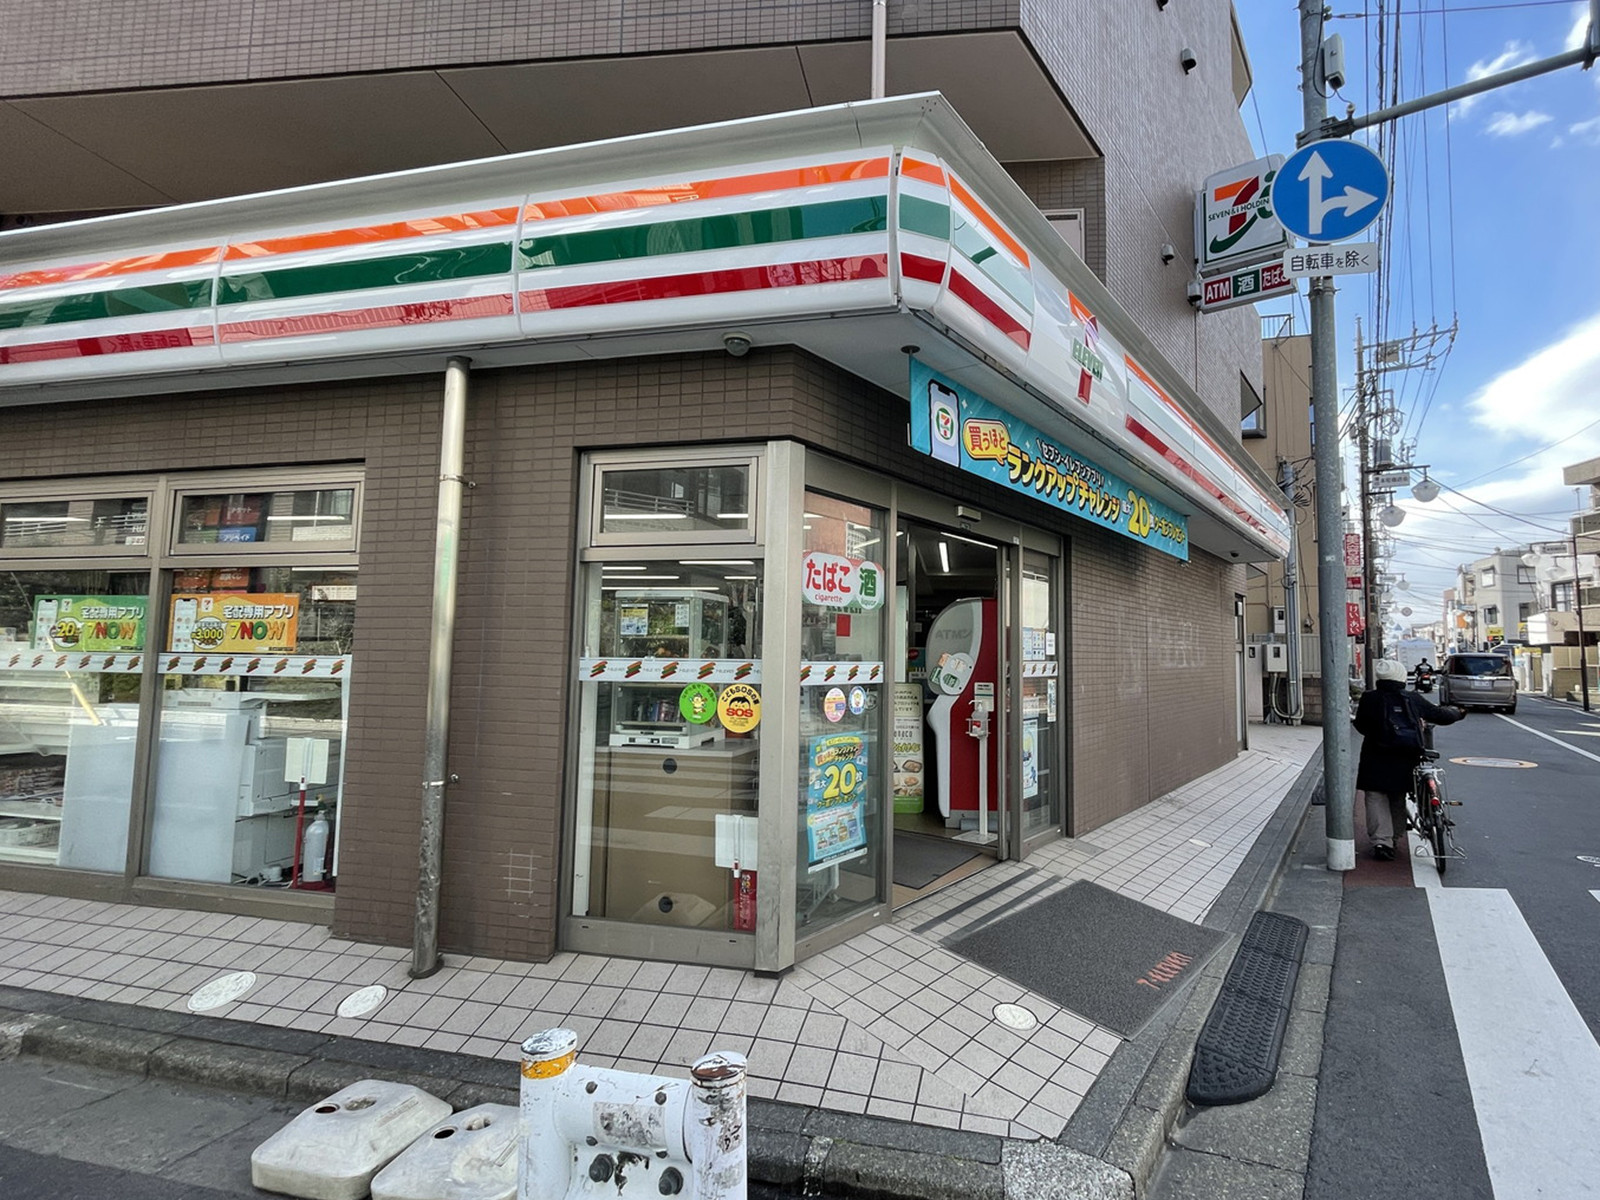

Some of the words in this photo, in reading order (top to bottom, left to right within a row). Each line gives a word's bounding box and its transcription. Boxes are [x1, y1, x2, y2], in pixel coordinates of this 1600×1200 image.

[1240, 198, 1270, 212] HOLDIN
[1291, 251, 1370, 272] 自転車を除く
[1206, 281, 1230, 302] ATM
[1237, 274, 1255, 294] 酒
[968, 425, 1007, 452] 買うほど
[1006, 447, 1120, 522] ランクアップチャレンジ
[806, 558, 851, 593] たばこ
[859, 567, 877, 597] 酒
[814, 593, 843, 603] cigarette
[223, 605, 295, 620] 宅配専用アプリ
[86, 621, 136, 640] 7NOW
[229, 621, 286, 641] 7NOW
[935, 629, 962, 640] ATM
[726, 708, 754, 717] SOS
